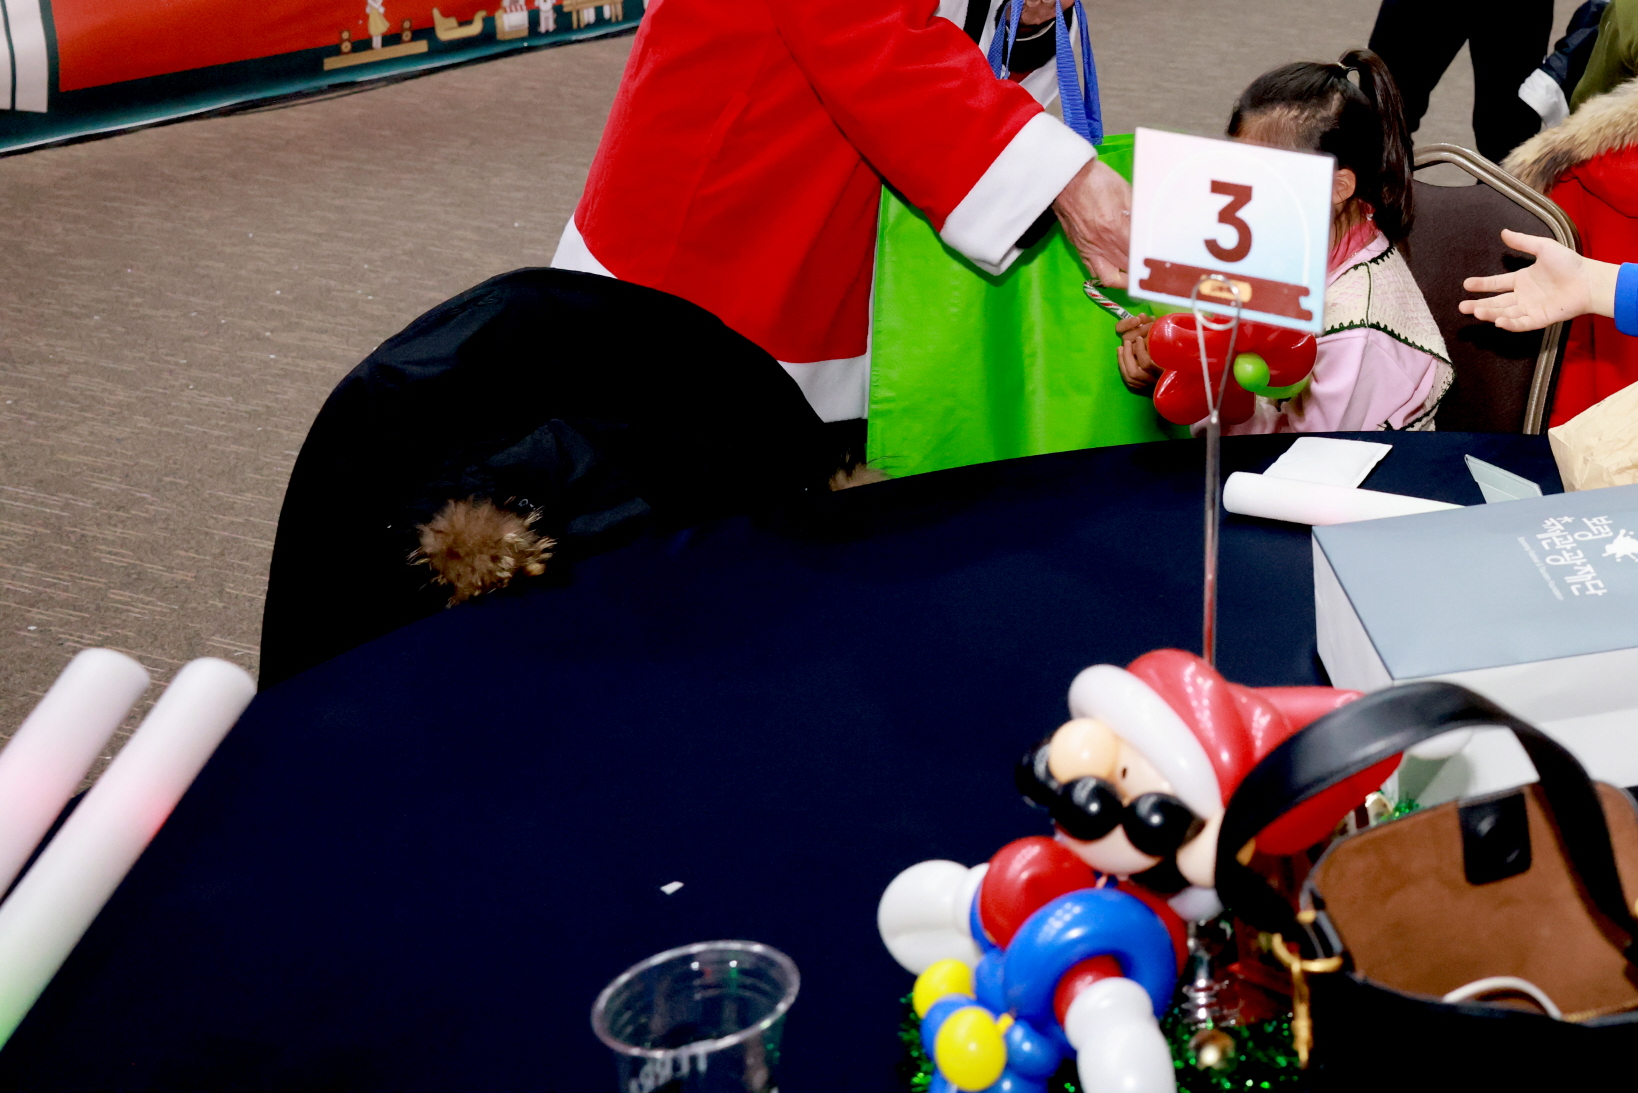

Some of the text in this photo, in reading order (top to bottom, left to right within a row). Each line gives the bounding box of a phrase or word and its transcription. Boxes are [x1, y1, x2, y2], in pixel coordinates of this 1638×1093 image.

[1204, 179, 1253, 262] 3
[1535, 515, 1607, 596] 축제관광재단
[1573, 515, 1614, 541] 보령
